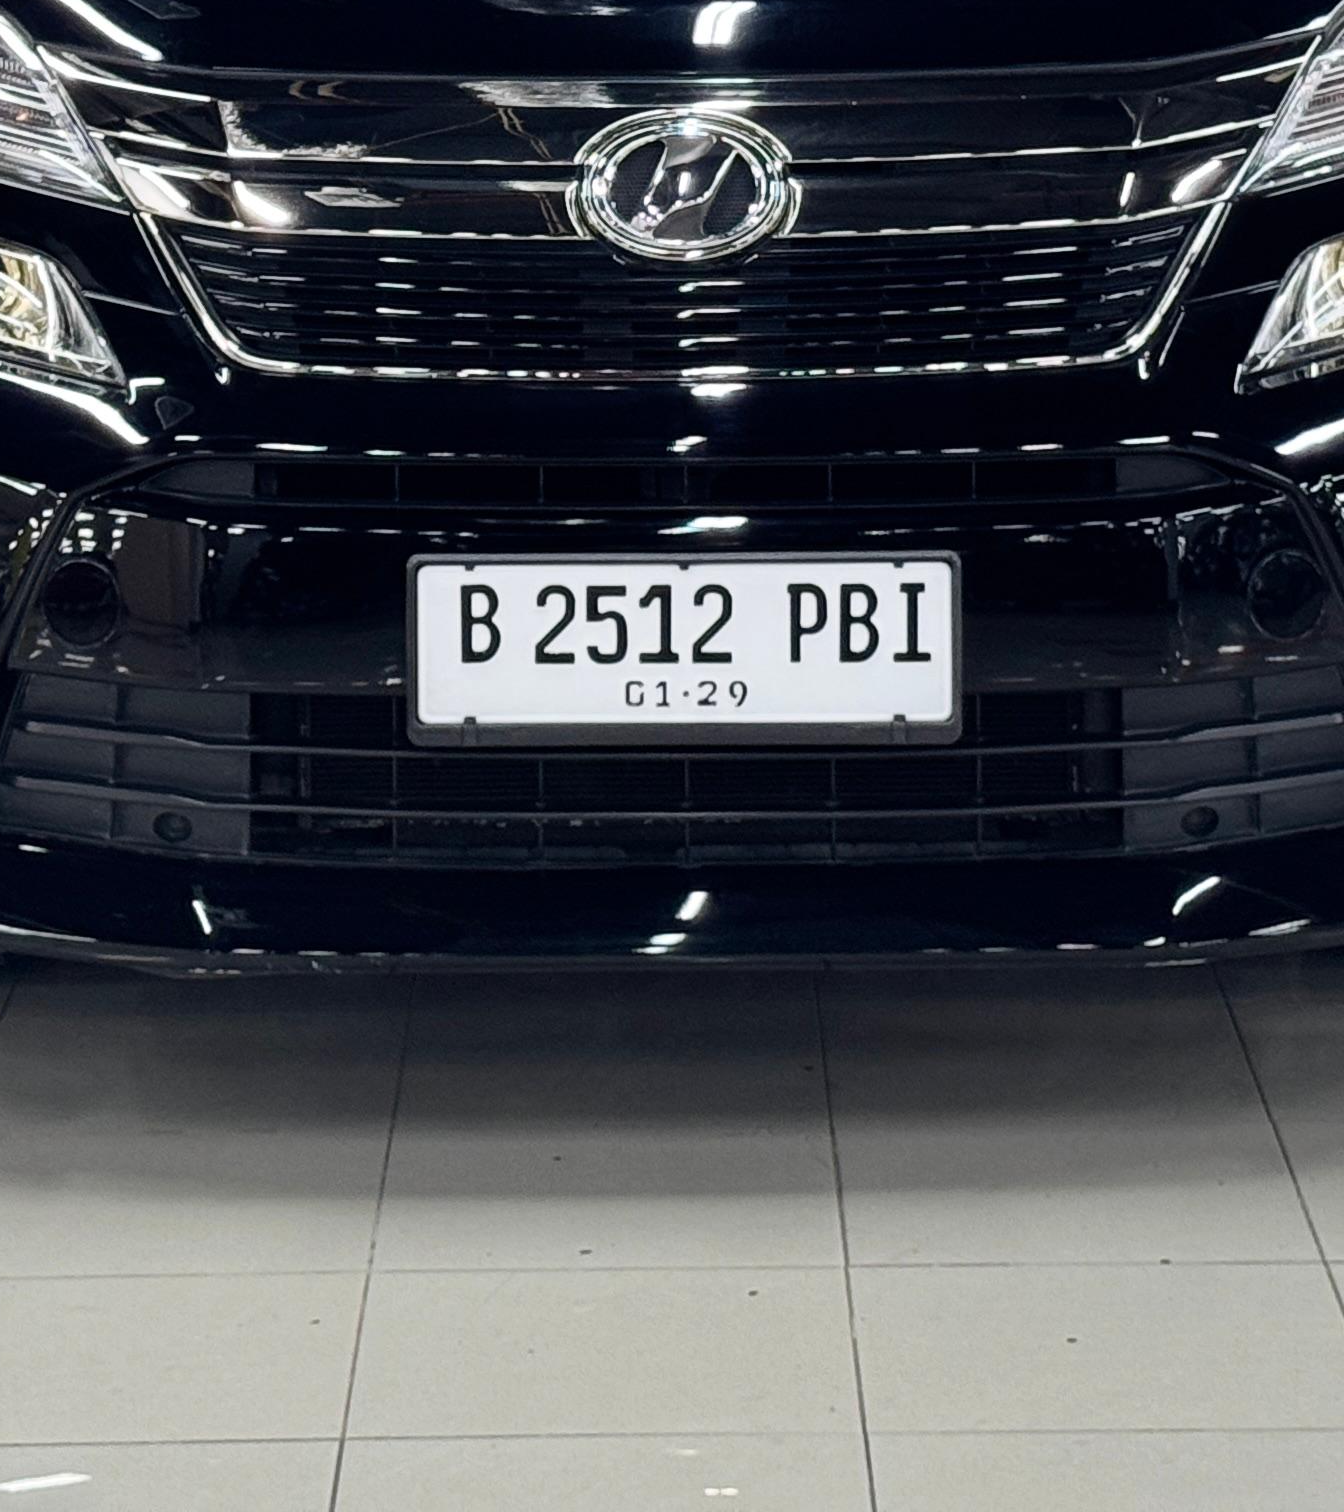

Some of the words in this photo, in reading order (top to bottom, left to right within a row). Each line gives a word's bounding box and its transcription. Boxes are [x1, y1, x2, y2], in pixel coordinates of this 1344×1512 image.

[460, 584, 501, 663] B
[534, 584, 733, 664] 2512
[787, 582, 932, 663] PBI
